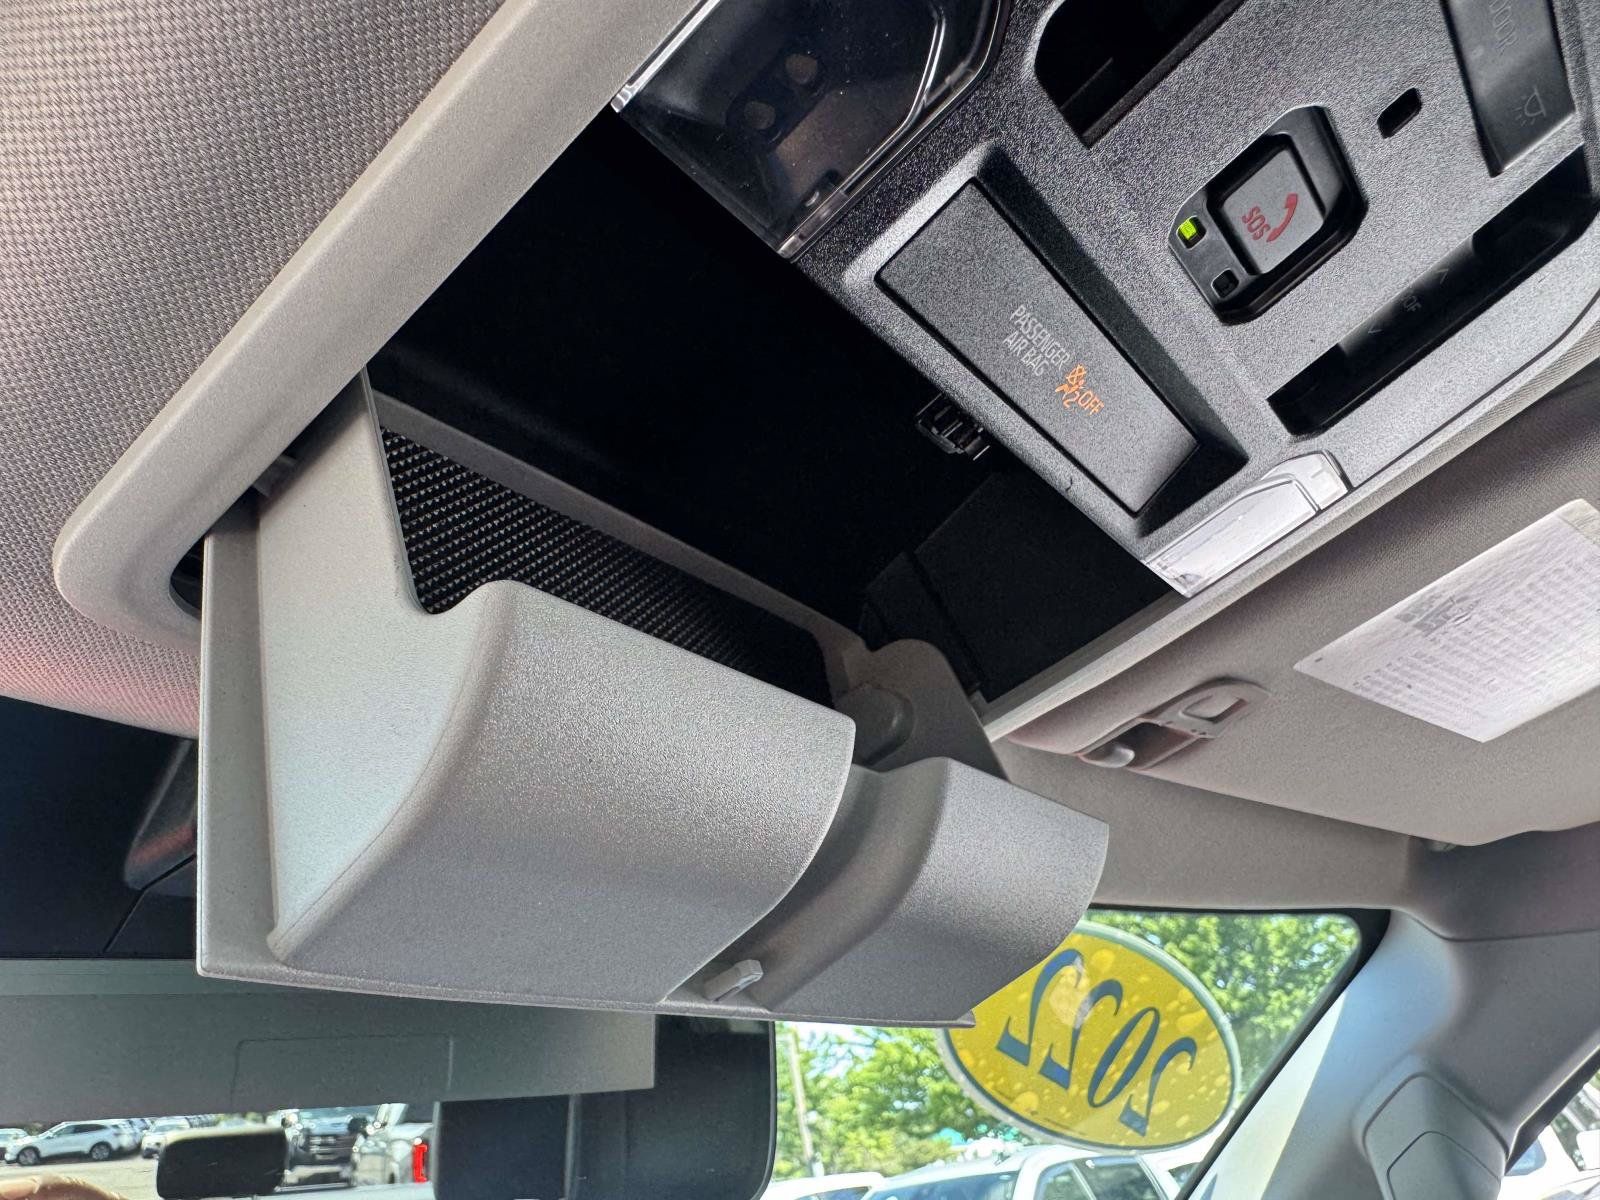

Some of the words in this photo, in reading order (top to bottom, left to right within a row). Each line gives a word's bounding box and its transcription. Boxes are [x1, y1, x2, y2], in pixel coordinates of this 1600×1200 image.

[1241, 205, 1271, 241] SOS
[1002, 330, 1028, 357] AIR
[1020, 346, 1049, 377] BAG
[1009, 304, 1070, 371] PASSENGER
[1078, 389, 1105, 416] OFF
